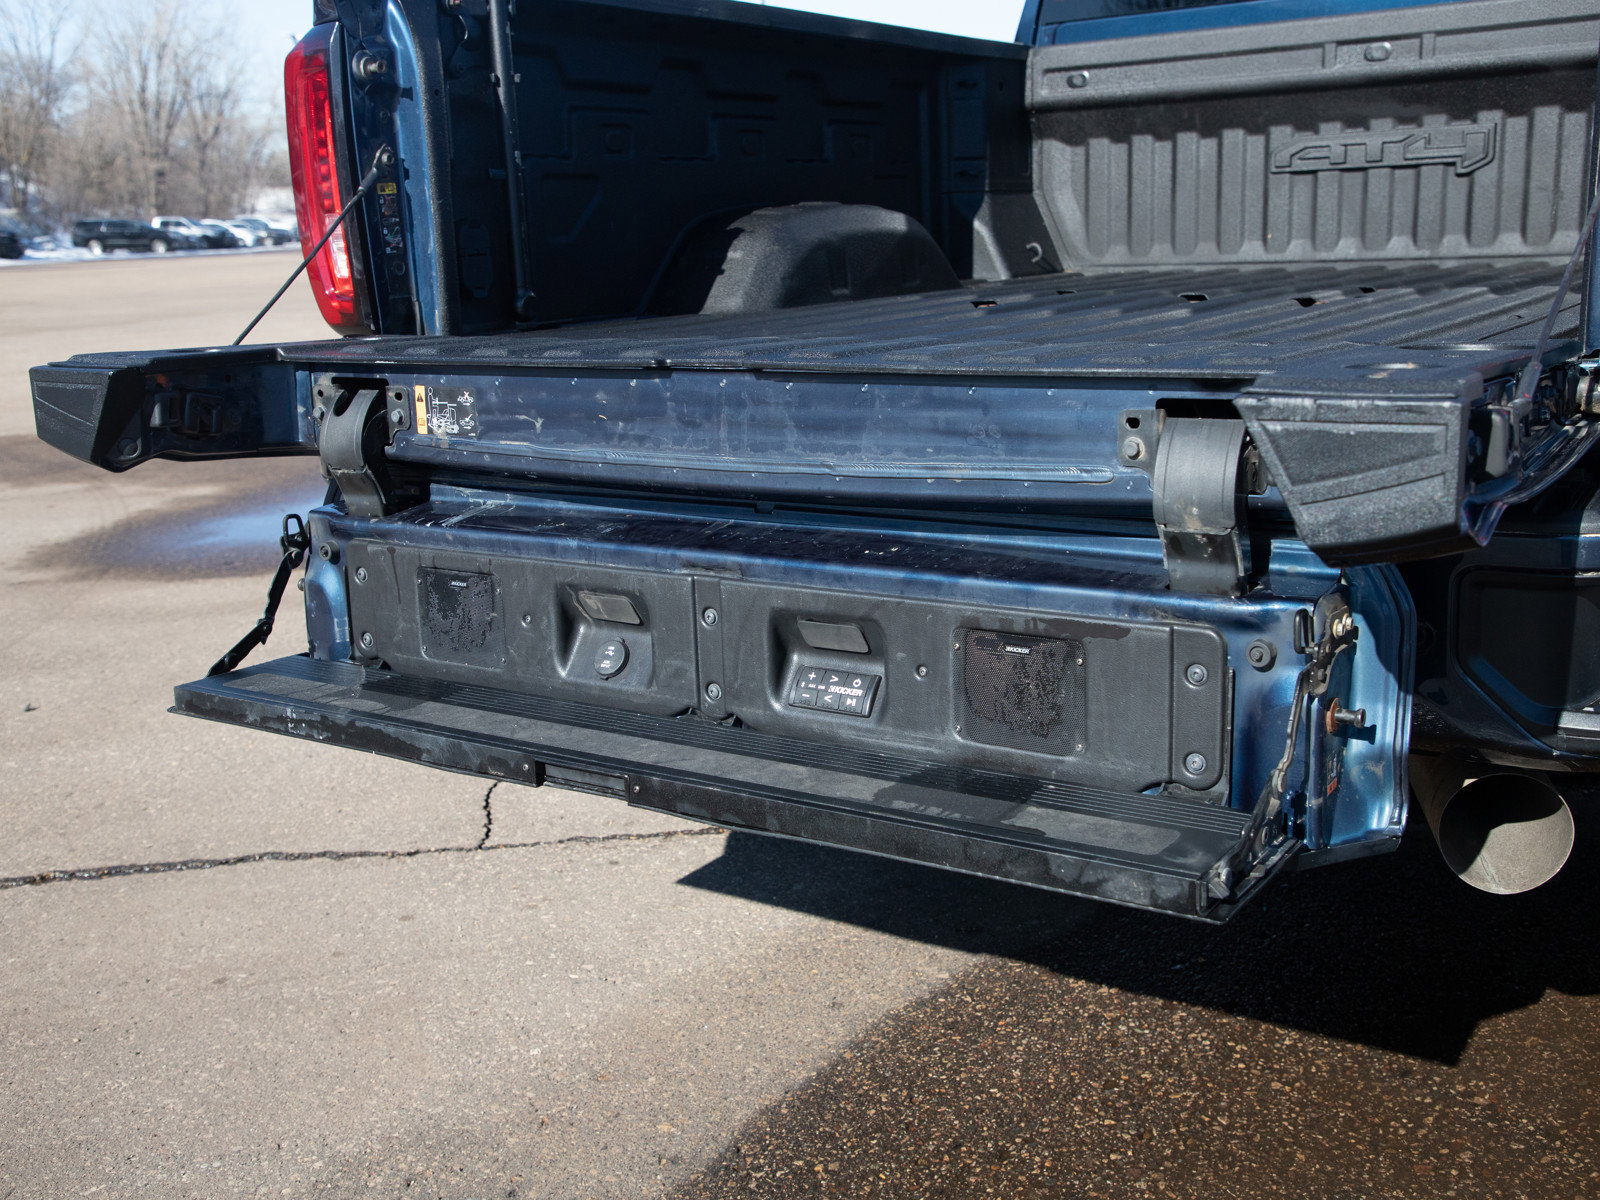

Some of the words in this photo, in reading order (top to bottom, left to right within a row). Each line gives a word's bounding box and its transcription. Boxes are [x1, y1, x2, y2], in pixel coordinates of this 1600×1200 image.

[1271, 122, 1497, 177] AT4
[1006, 646, 1029, 654] KICKER
[829, 685, 863, 696] KICKER
